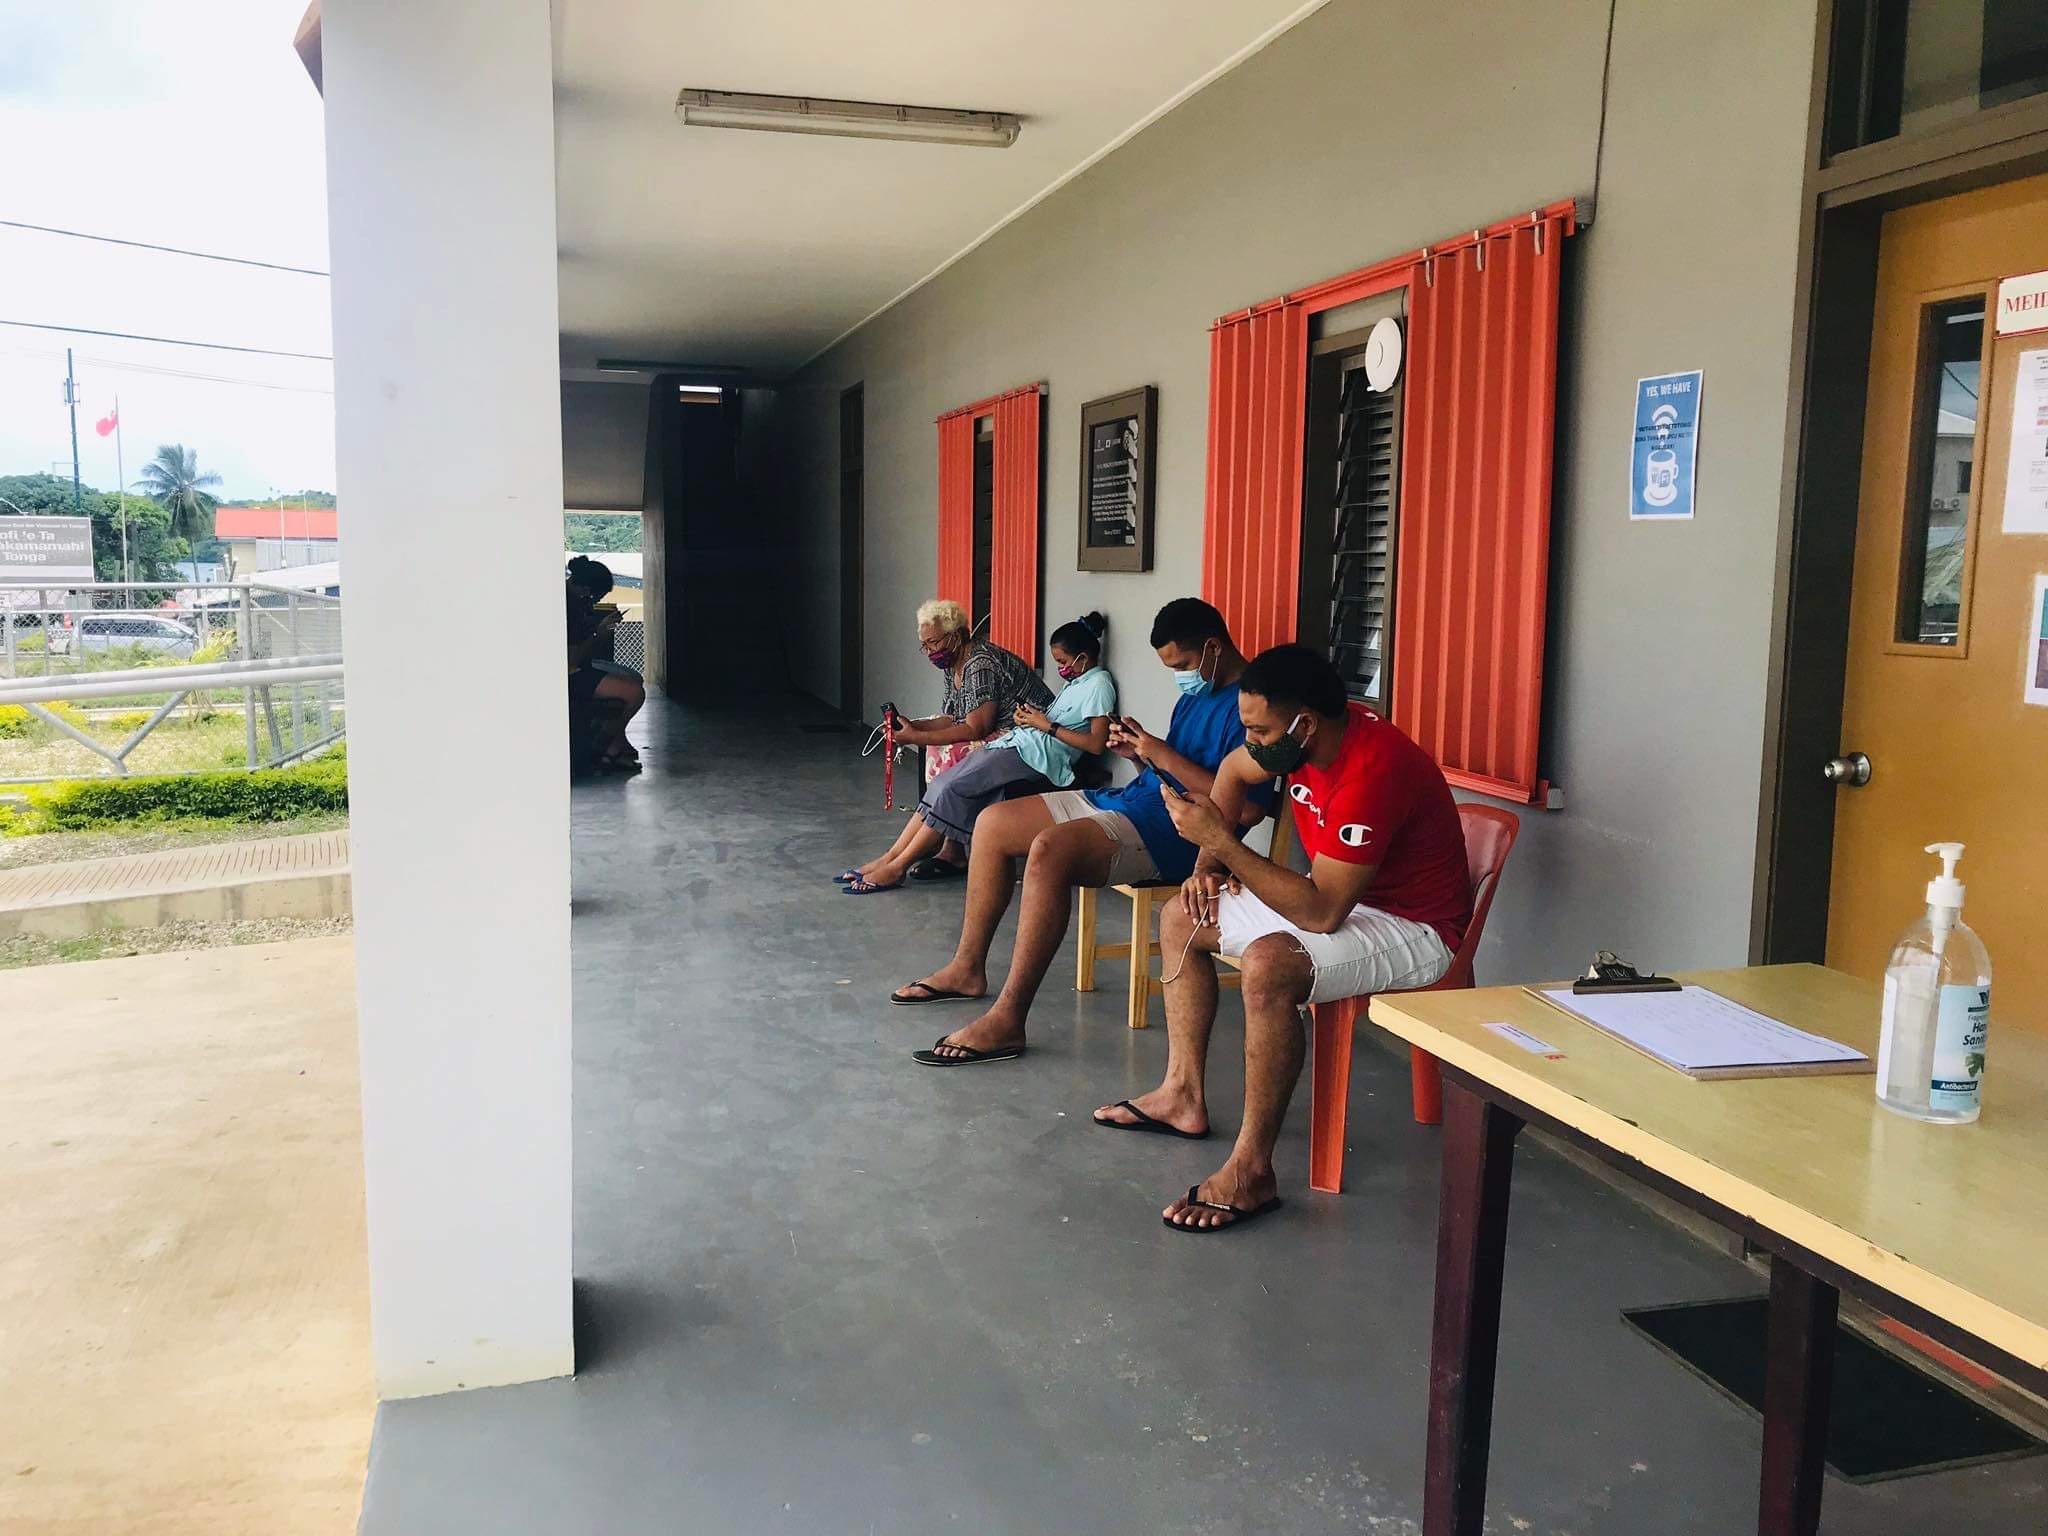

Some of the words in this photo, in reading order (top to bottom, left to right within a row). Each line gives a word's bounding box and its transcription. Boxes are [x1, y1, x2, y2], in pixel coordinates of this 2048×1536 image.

[1660, 383, 1672, 395] WE
[1672, 381, 1691, 394] HAVE
[3, 551, 47, 562] Tonga
